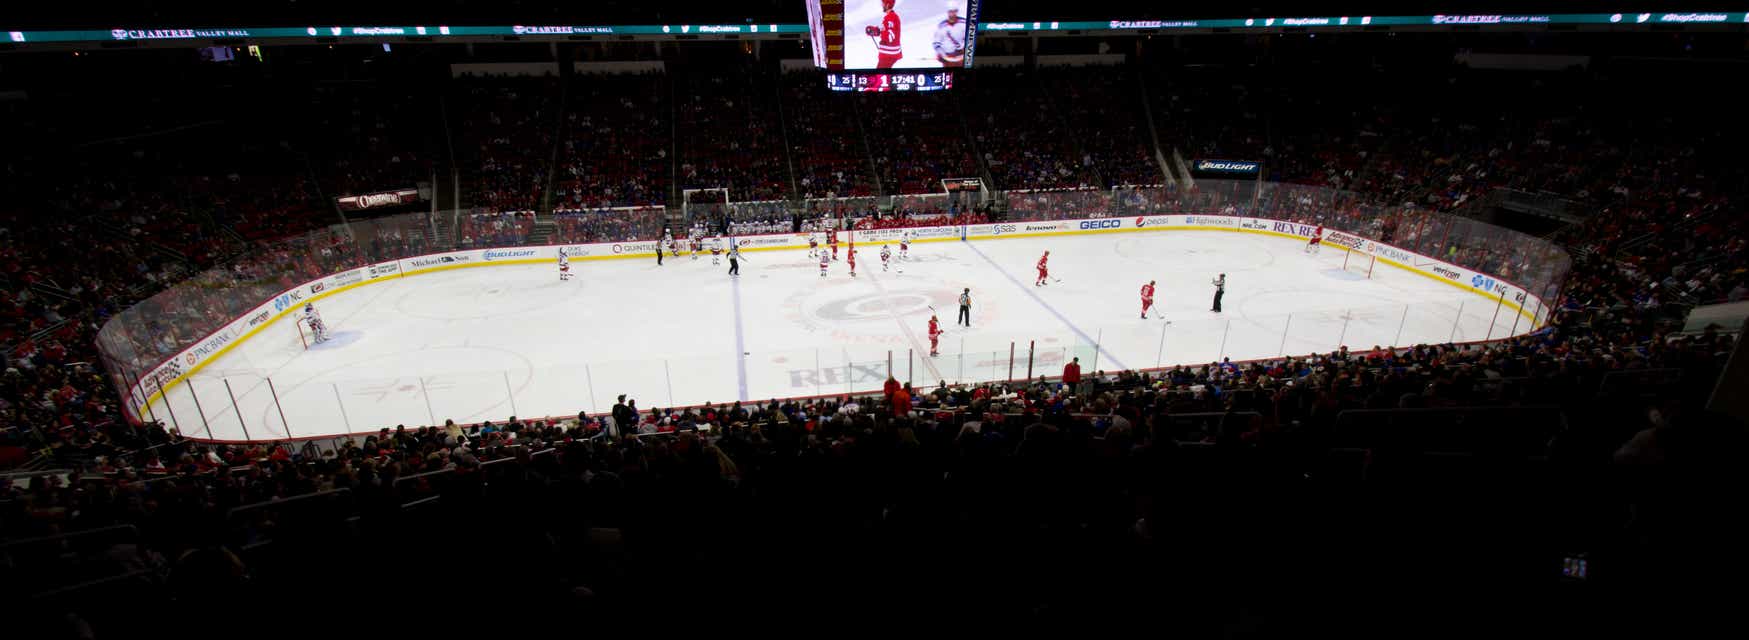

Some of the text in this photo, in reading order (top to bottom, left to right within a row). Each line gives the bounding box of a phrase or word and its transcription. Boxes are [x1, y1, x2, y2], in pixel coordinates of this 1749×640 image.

[128, 29, 195, 39] CRABTREE
[526, 26, 573, 34] CRABTREE
[880, 75, 889, 87] 1
[891, 75, 915, 84] 17:41
[917, 74, 925, 86] 0
[1080, 219, 1121, 230] GEICO
[1273, 221, 1296, 235] REX
[624, 244, 657, 252] QUINTILE
